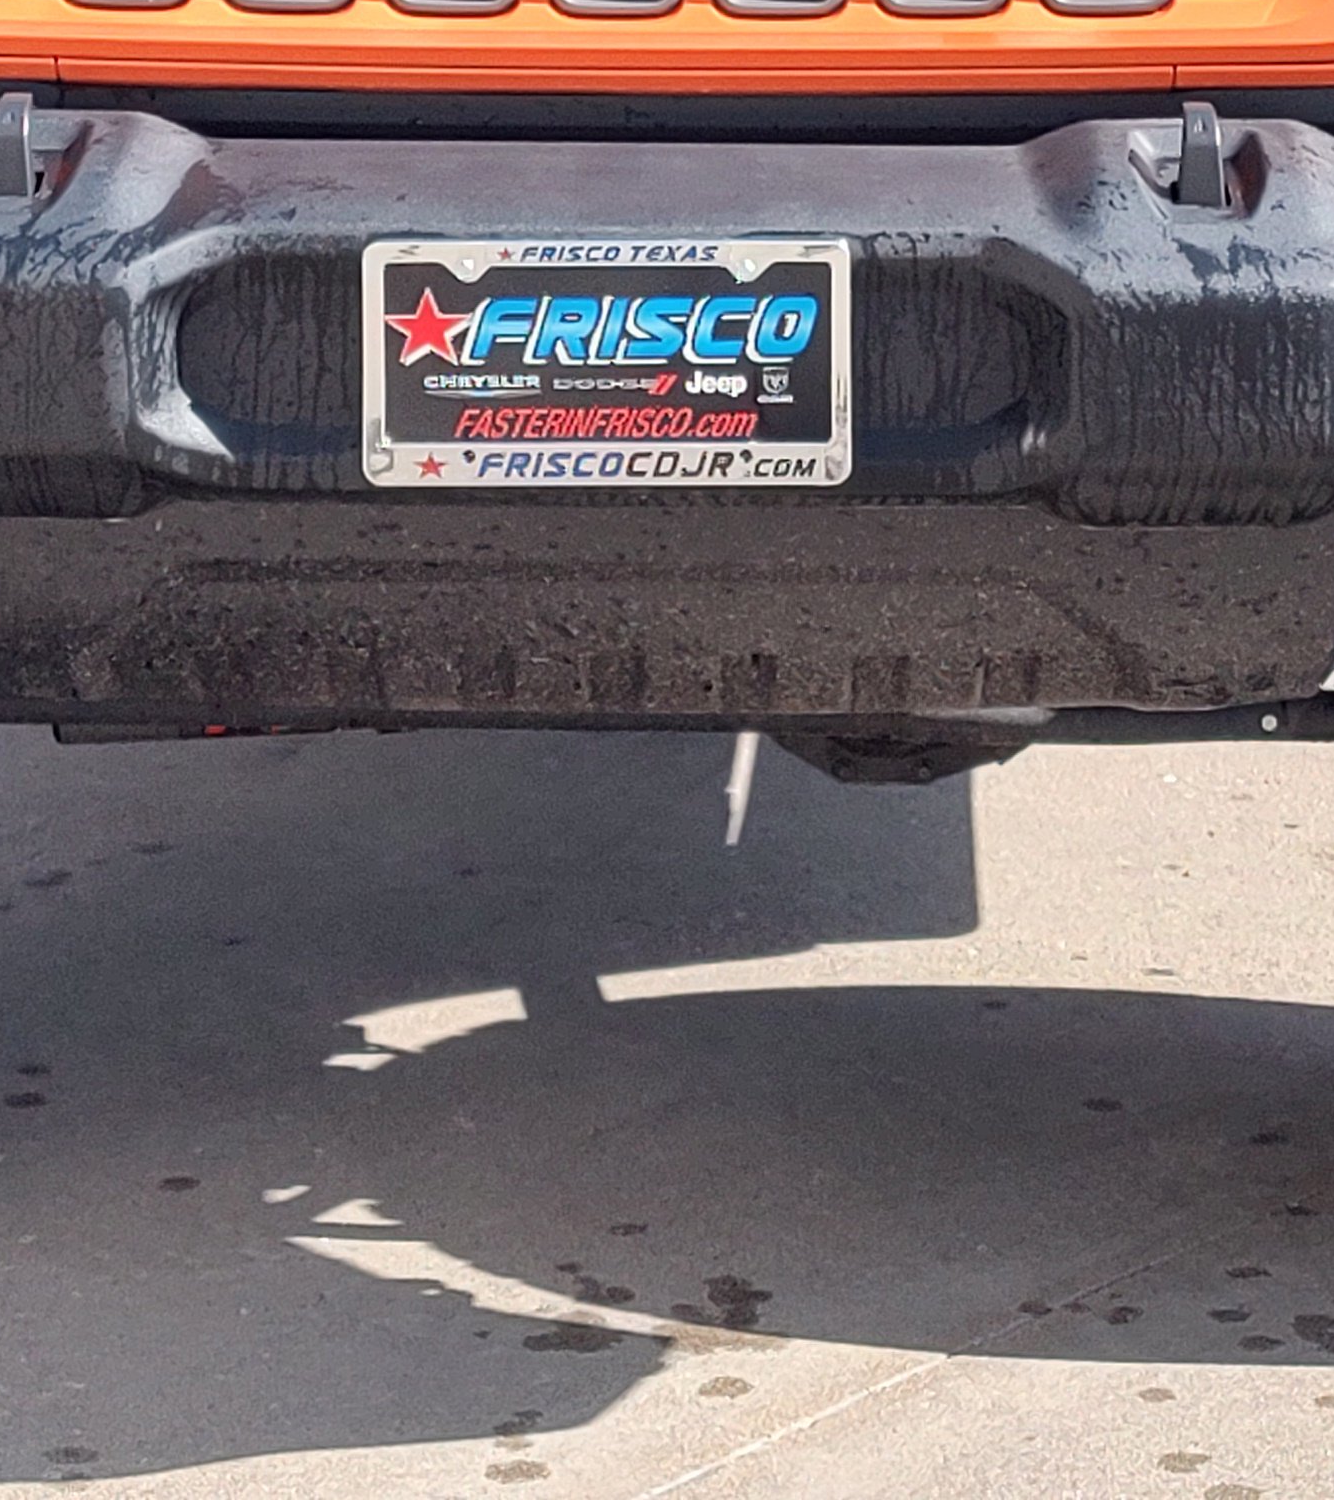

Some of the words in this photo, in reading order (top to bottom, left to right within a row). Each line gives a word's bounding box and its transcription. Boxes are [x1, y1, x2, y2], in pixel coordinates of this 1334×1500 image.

[519, 245, 621, 262] FRISCO
[630, 245, 719, 262] TEXAS
[462, 295, 819, 365] FRISCO
[684, 370, 748, 397] Jeep
[454, 406, 758, 438] FASTERINFRISCO.com
